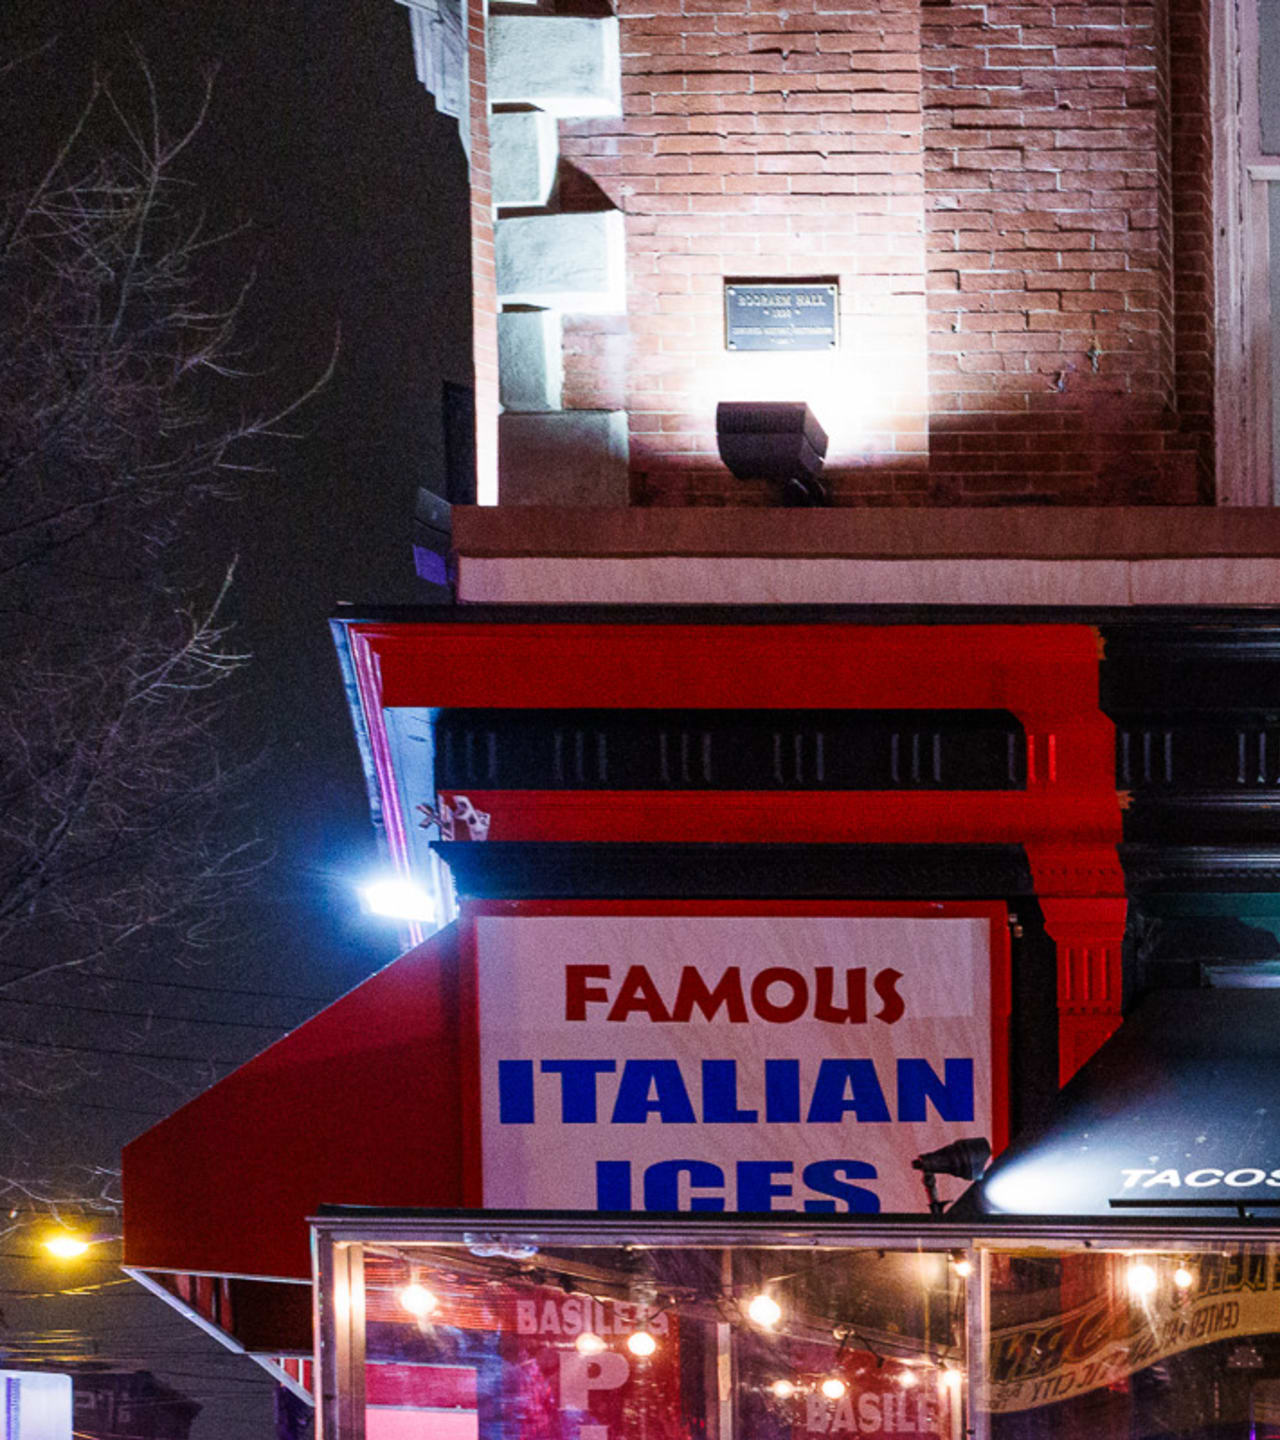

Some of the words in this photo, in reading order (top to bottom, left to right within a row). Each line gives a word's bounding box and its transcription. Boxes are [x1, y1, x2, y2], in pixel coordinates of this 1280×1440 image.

[565, 963, 906, 1025] FAMOUS
[498, 1058, 975, 1125] ITALIAN
[595, 1158, 882, 1212] ICES
